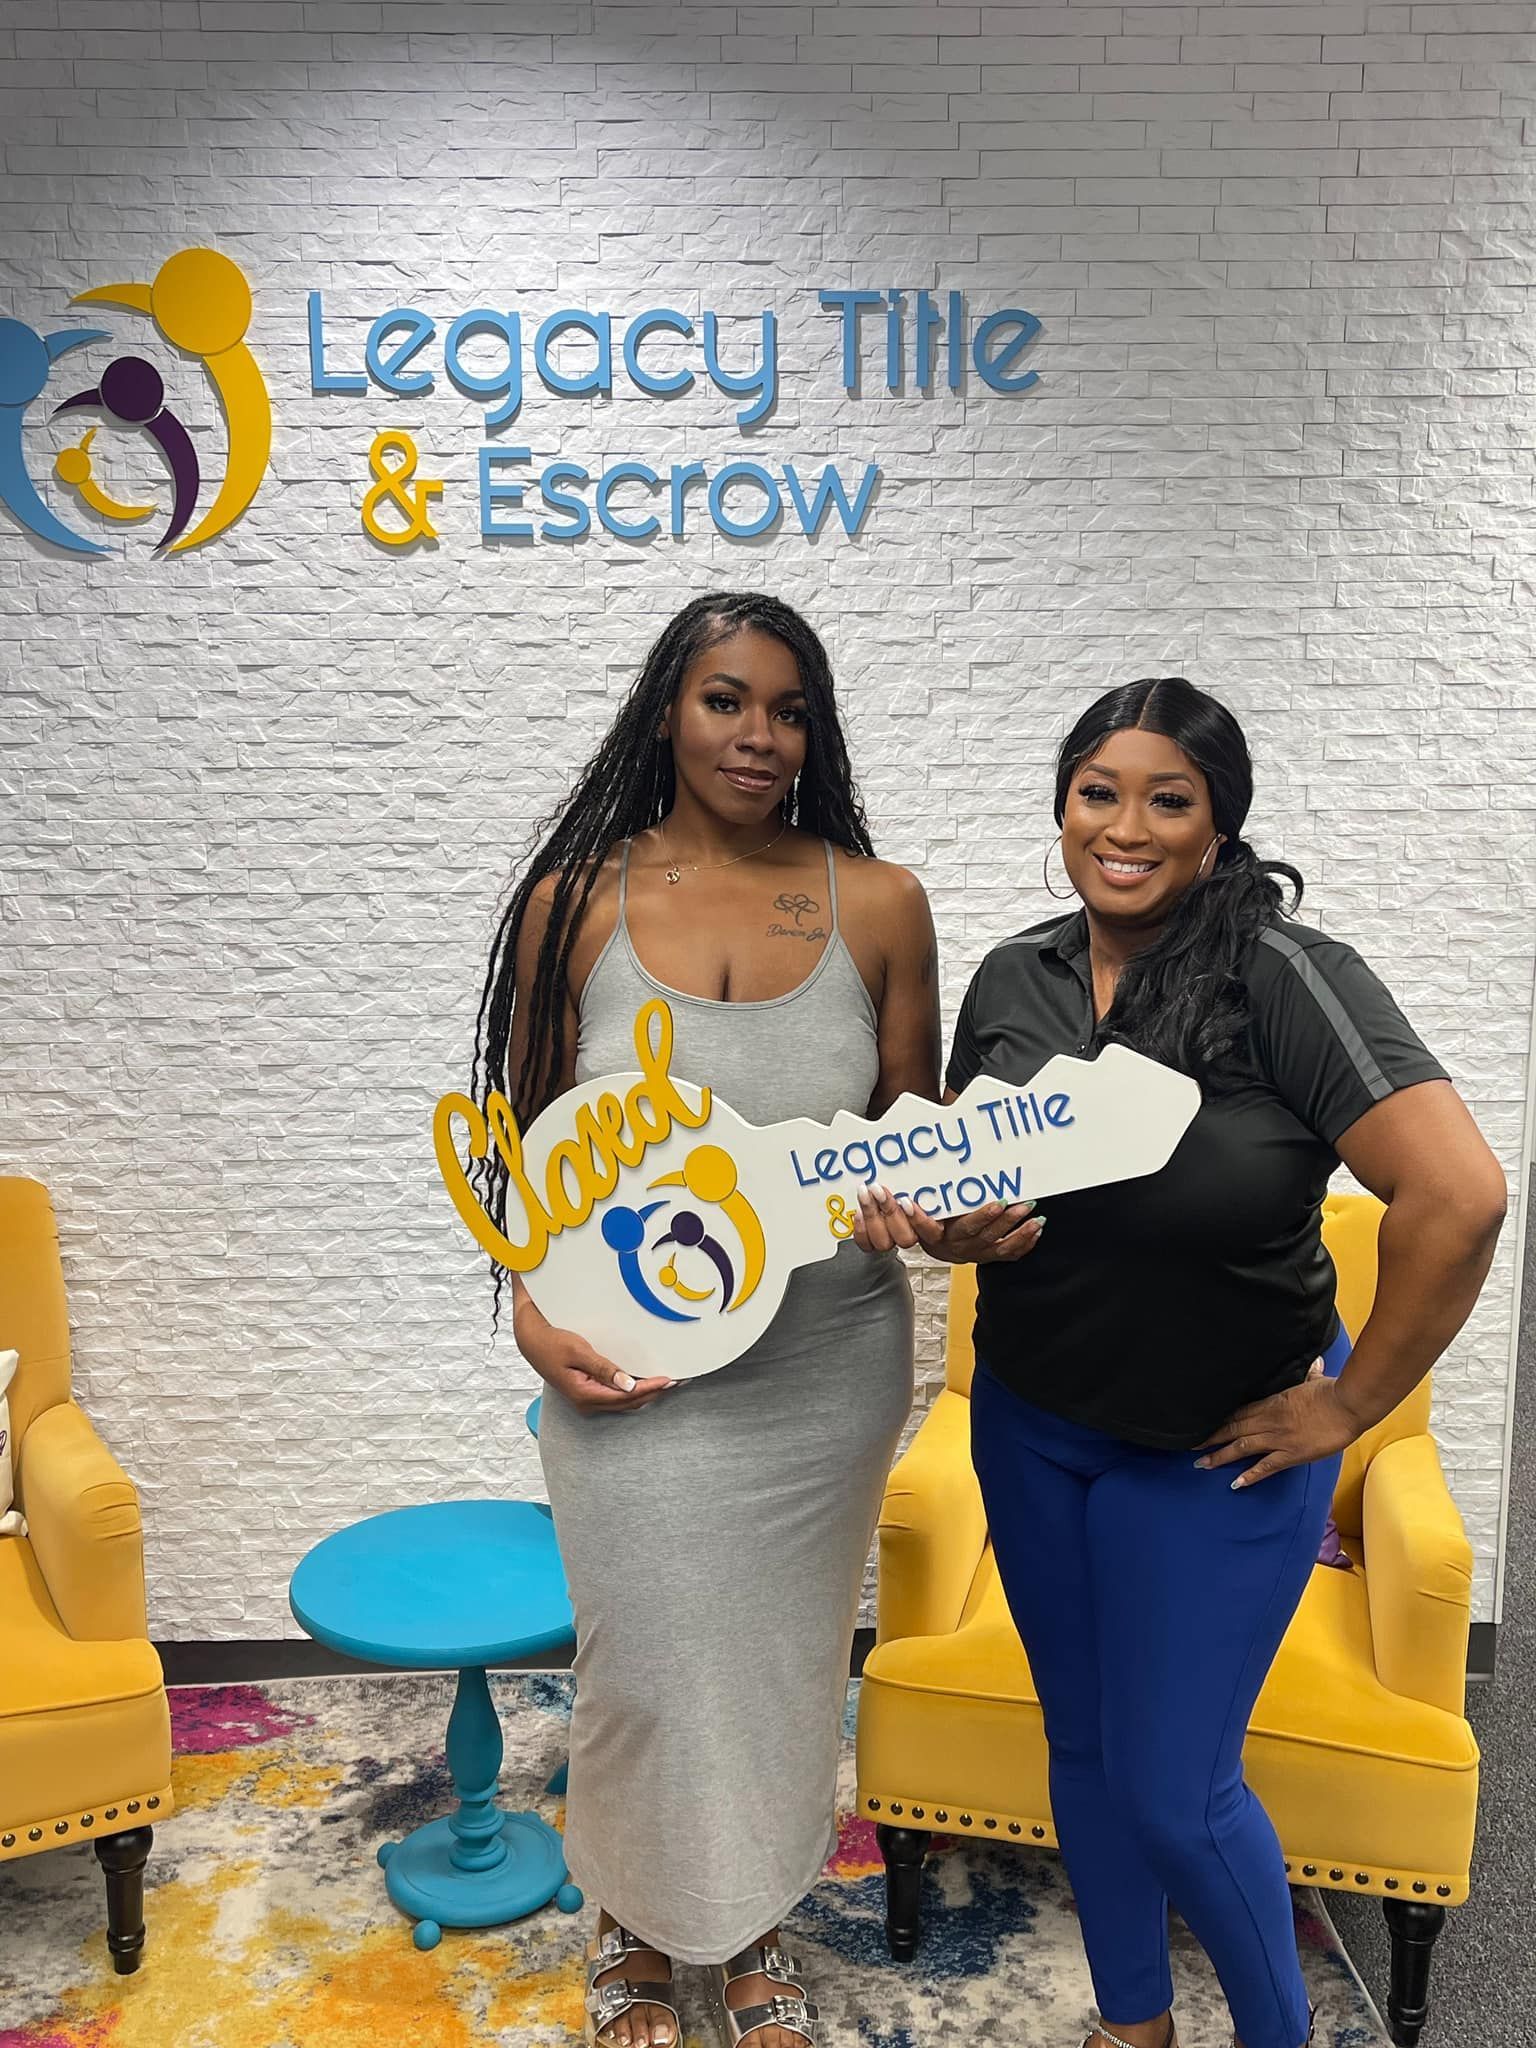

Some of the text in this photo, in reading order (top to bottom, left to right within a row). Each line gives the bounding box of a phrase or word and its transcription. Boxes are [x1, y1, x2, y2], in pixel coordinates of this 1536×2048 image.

[309, 289, 1043, 425] Legacy Title
[361, 431, 882, 545] & Escrow
[432, 998, 713, 1272] Closed
[790, 1089, 1075, 1187] Legacy Title
[826, 1166, 1022, 1239] & crow
